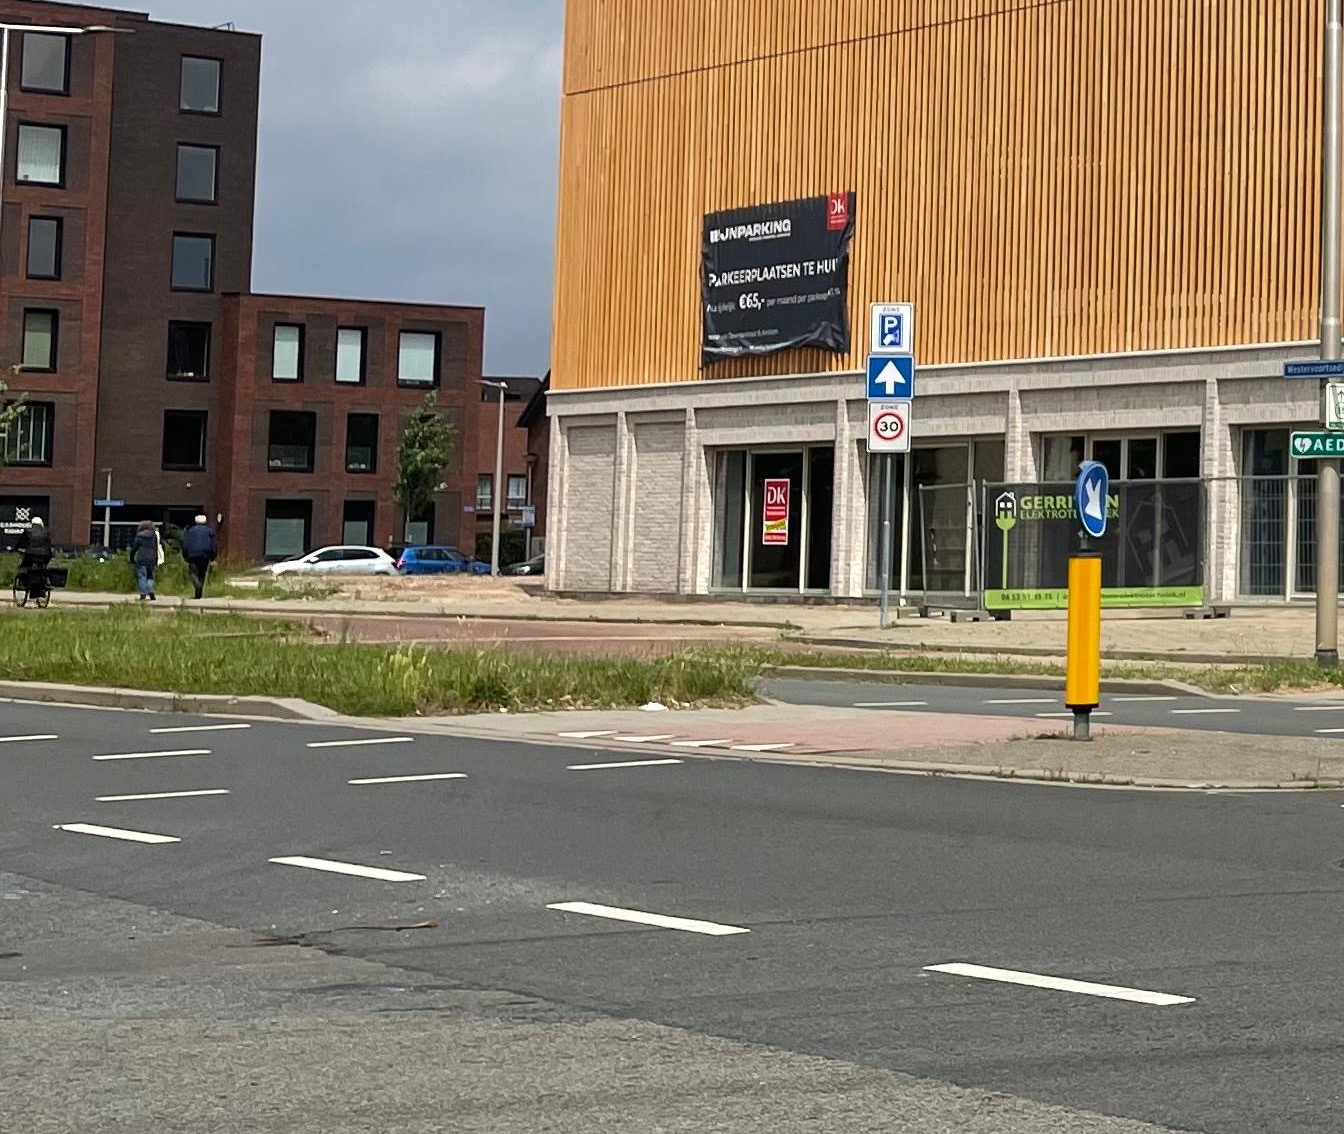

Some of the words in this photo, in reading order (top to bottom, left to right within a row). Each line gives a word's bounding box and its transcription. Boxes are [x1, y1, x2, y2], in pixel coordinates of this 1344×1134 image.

[803, 261, 815, 276] TE
[884, 316, 898, 335] P
[880, 421, 899, 432] 30
[767, 486, 786, 504] DK
